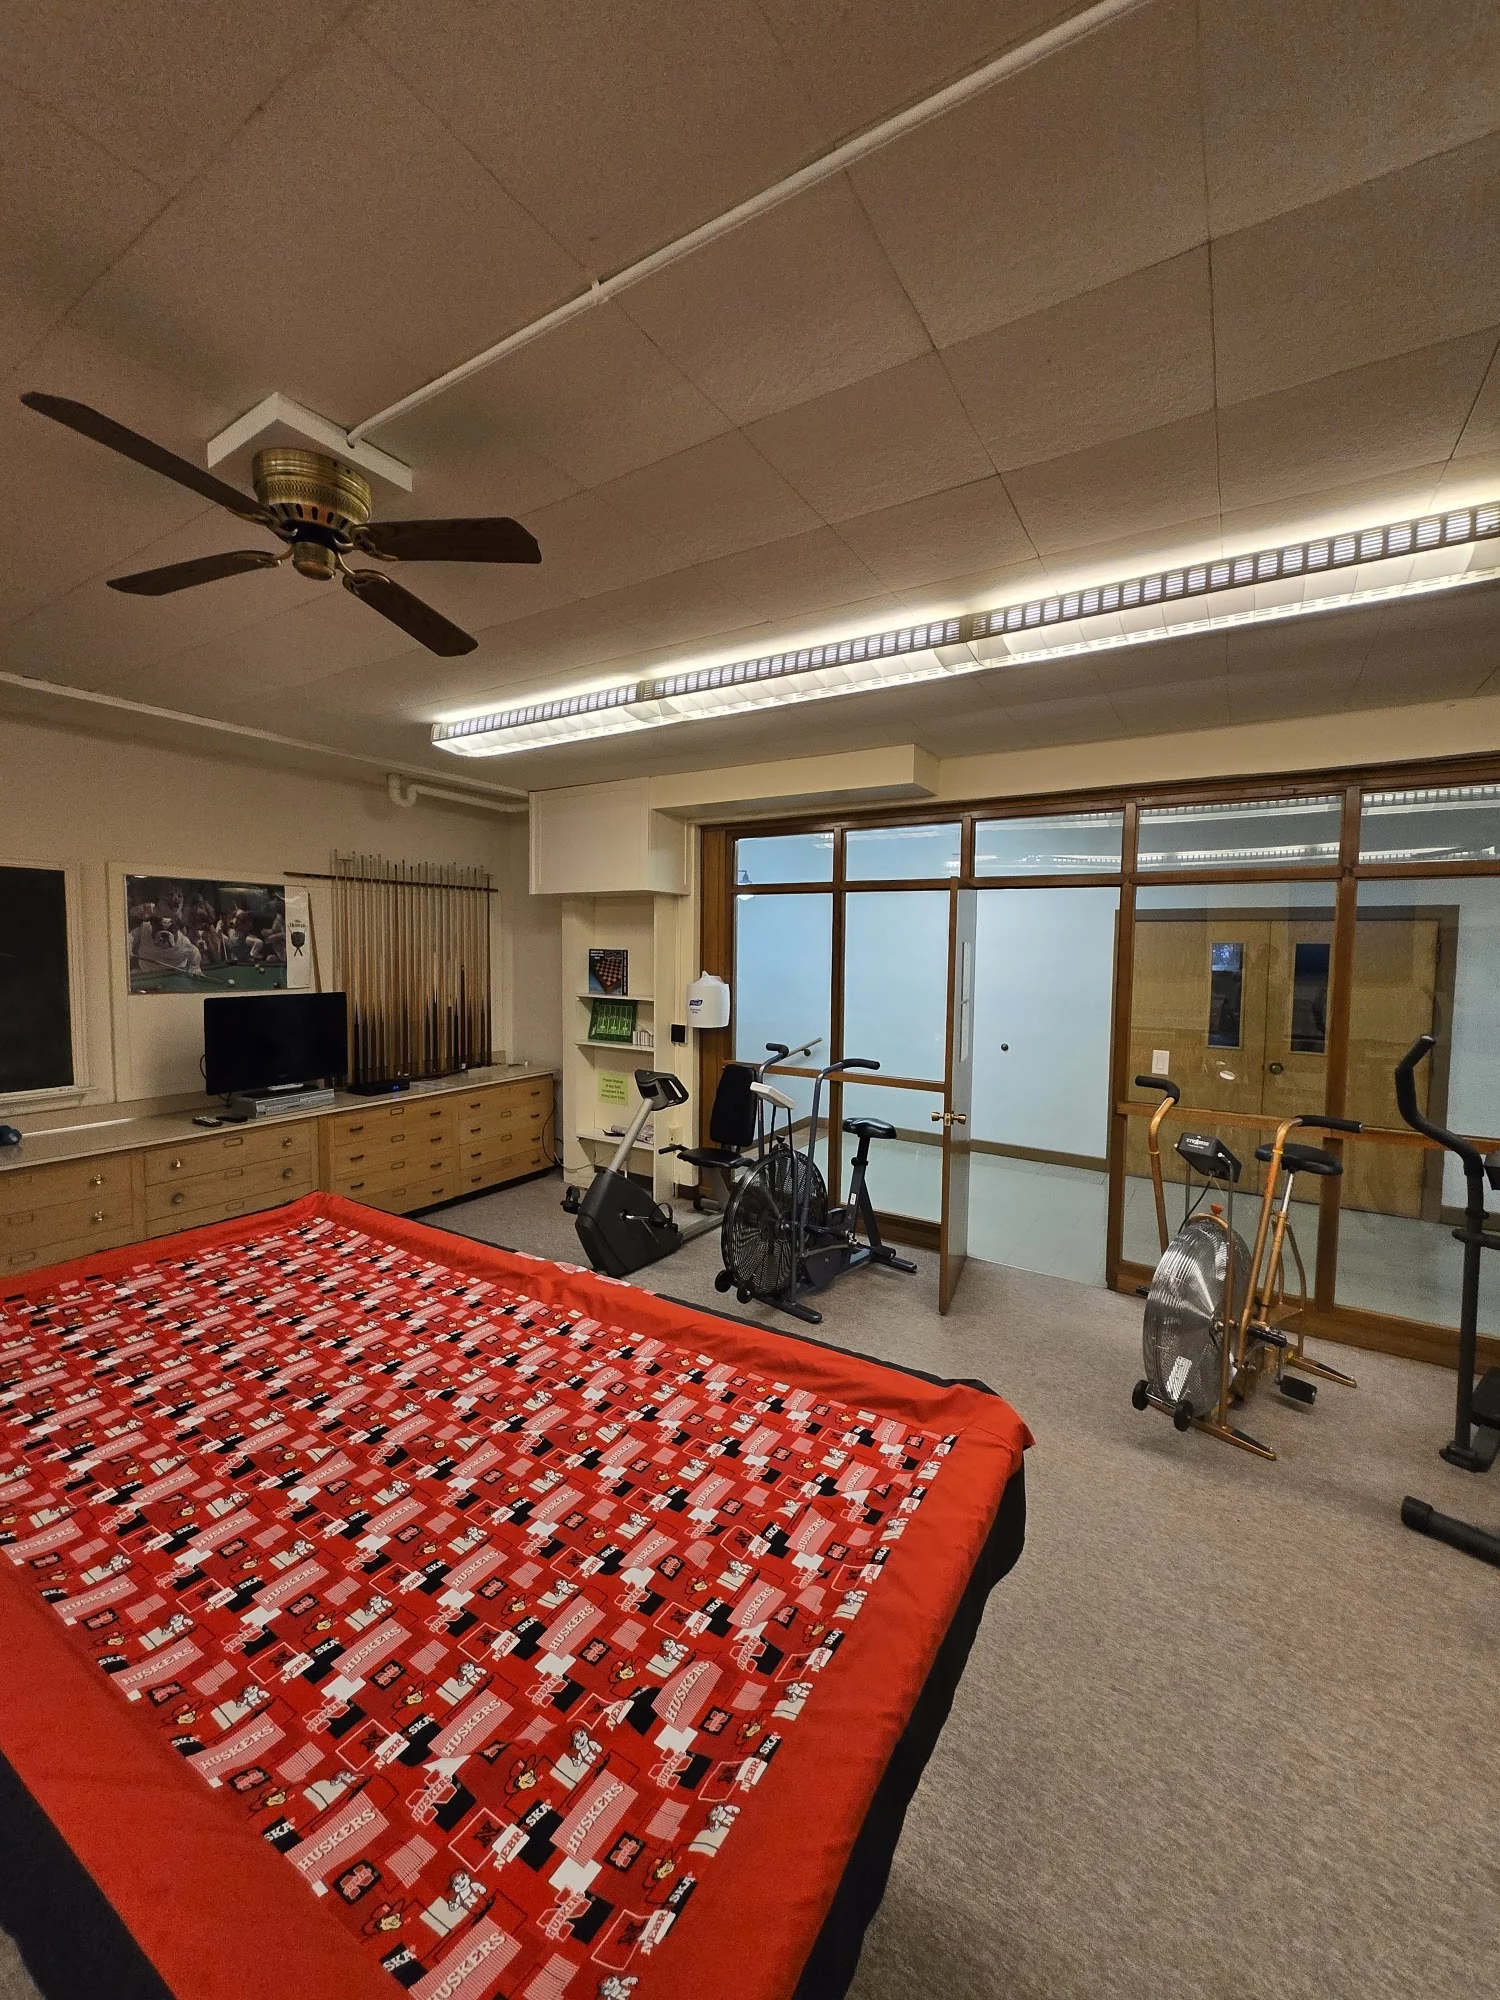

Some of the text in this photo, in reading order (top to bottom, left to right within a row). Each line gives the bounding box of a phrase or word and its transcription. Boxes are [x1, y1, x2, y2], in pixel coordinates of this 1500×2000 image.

[532, 1407, 564, 1430] HUSKERS
[607, 1439, 640, 1466] HUSKERS
[748, 1429, 774, 1455] HUSKERS
[304, 1458, 350, 1487] HUSKERS
[458, 1448, 498, 1478] HUSKERS
[845, 1465, 870, 1492] HUSKERS
[138, 1471, 194, 1502] HUSKERS
[695, 1477, 726, 1506] HUSKERS
[371, 1500, 420, 1534] HUSKERS
[537, 1489, 577, 1519] HUSKERS
[10, 1525, 77, 1555] HUSKERS
[196, 1514, 253, 1548] HUSKERS
[797, 1517, 826, 1552] HUSKERS
[631, 1536, 668, 1567] HUSKERS
[263, 1565, 320, 1605] HUSKERS
[452, 1550, 500, 1588] HUSKERS
[59, 1581, 131, 1613] HUSKERS
[740, 1585, 776, 1628] HUSKERS
[549, 1603, 596, 1651] HUSKERS
[121, 1645, 196, 1685] HUSKERS
[341, 1625, 402, 1674] HUSKERS
[737, 1634, 761, 1671] HUSKERS
[664, 1660, 711, 1723] HUSKERS
[442, 1699, 502, 1756] HUSKERS
[201, 1723, 276, 1771] HUSKERS
[412, 1774, 453, 1822] HUSKERS
[566, 1781, 625, 1855] HUSKERS
[298, 1807, 377, 1872] HUSKERS
[546, 1890, 585, 1939] HUSKERS
[382, 1949, 417, 1973] SKA
